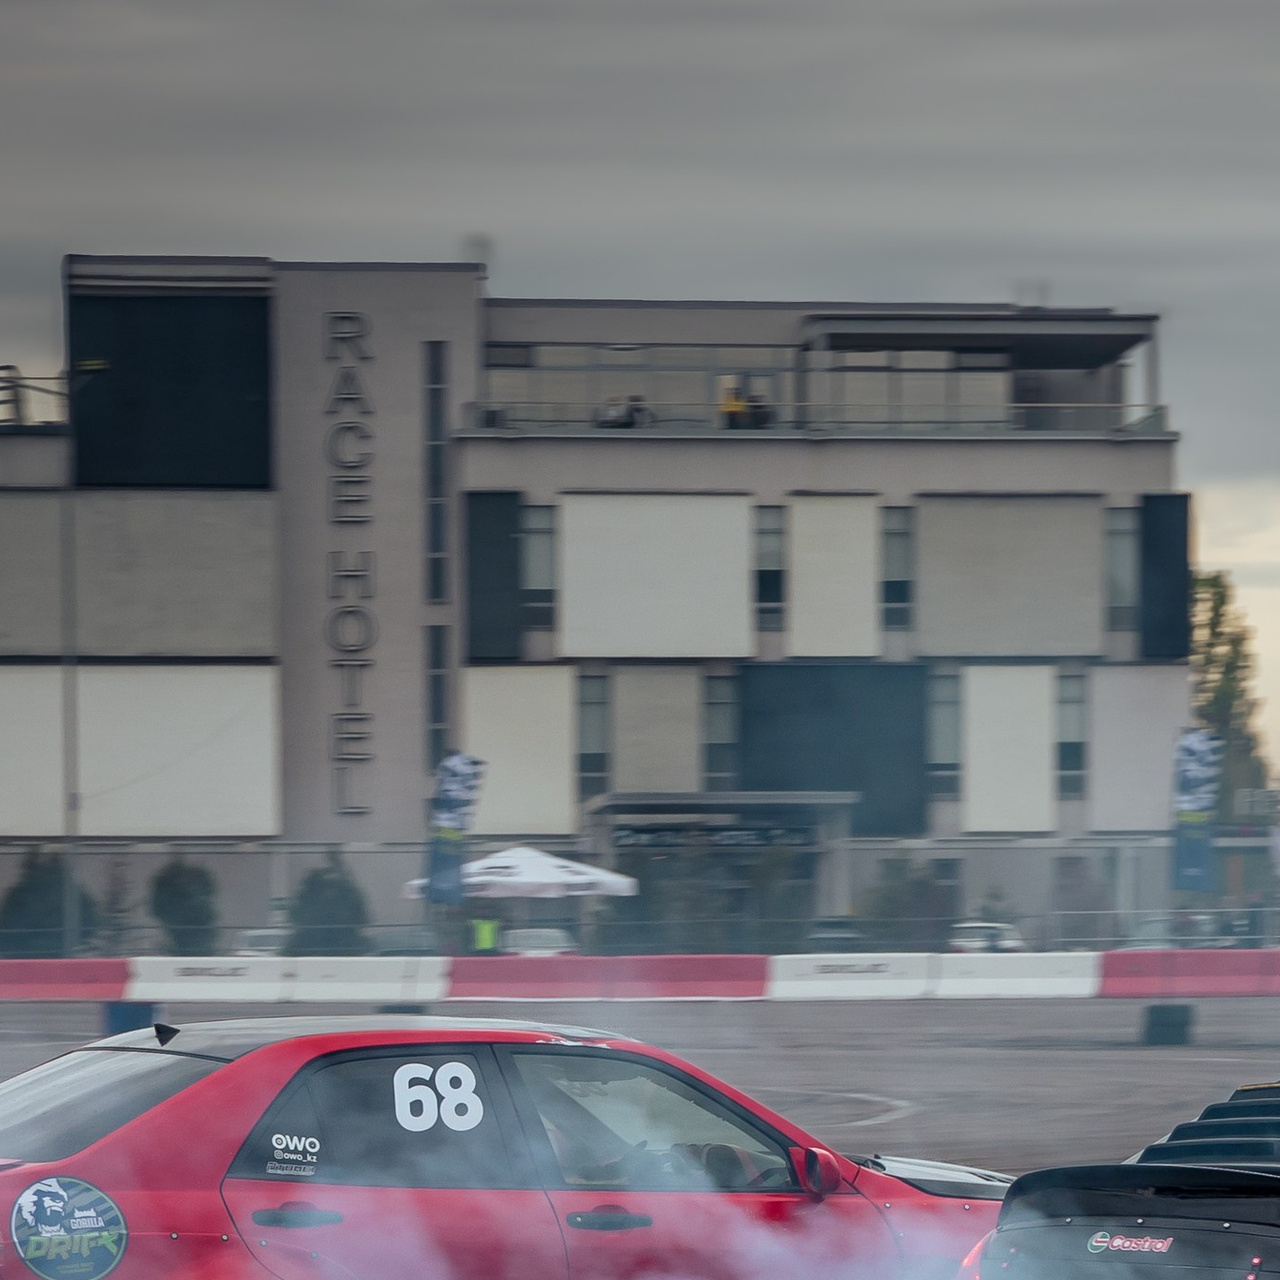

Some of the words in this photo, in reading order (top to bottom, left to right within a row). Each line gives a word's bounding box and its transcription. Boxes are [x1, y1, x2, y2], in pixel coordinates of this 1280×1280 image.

[323, 311, 376, 524] RACE
[325, 551, 380, 816] HOTEL
[393, 1062, 484, 1132] 68
[70, 1217, 105, 1230] GORILLA
[1109, 1234, 1174, 1253] Castrol
